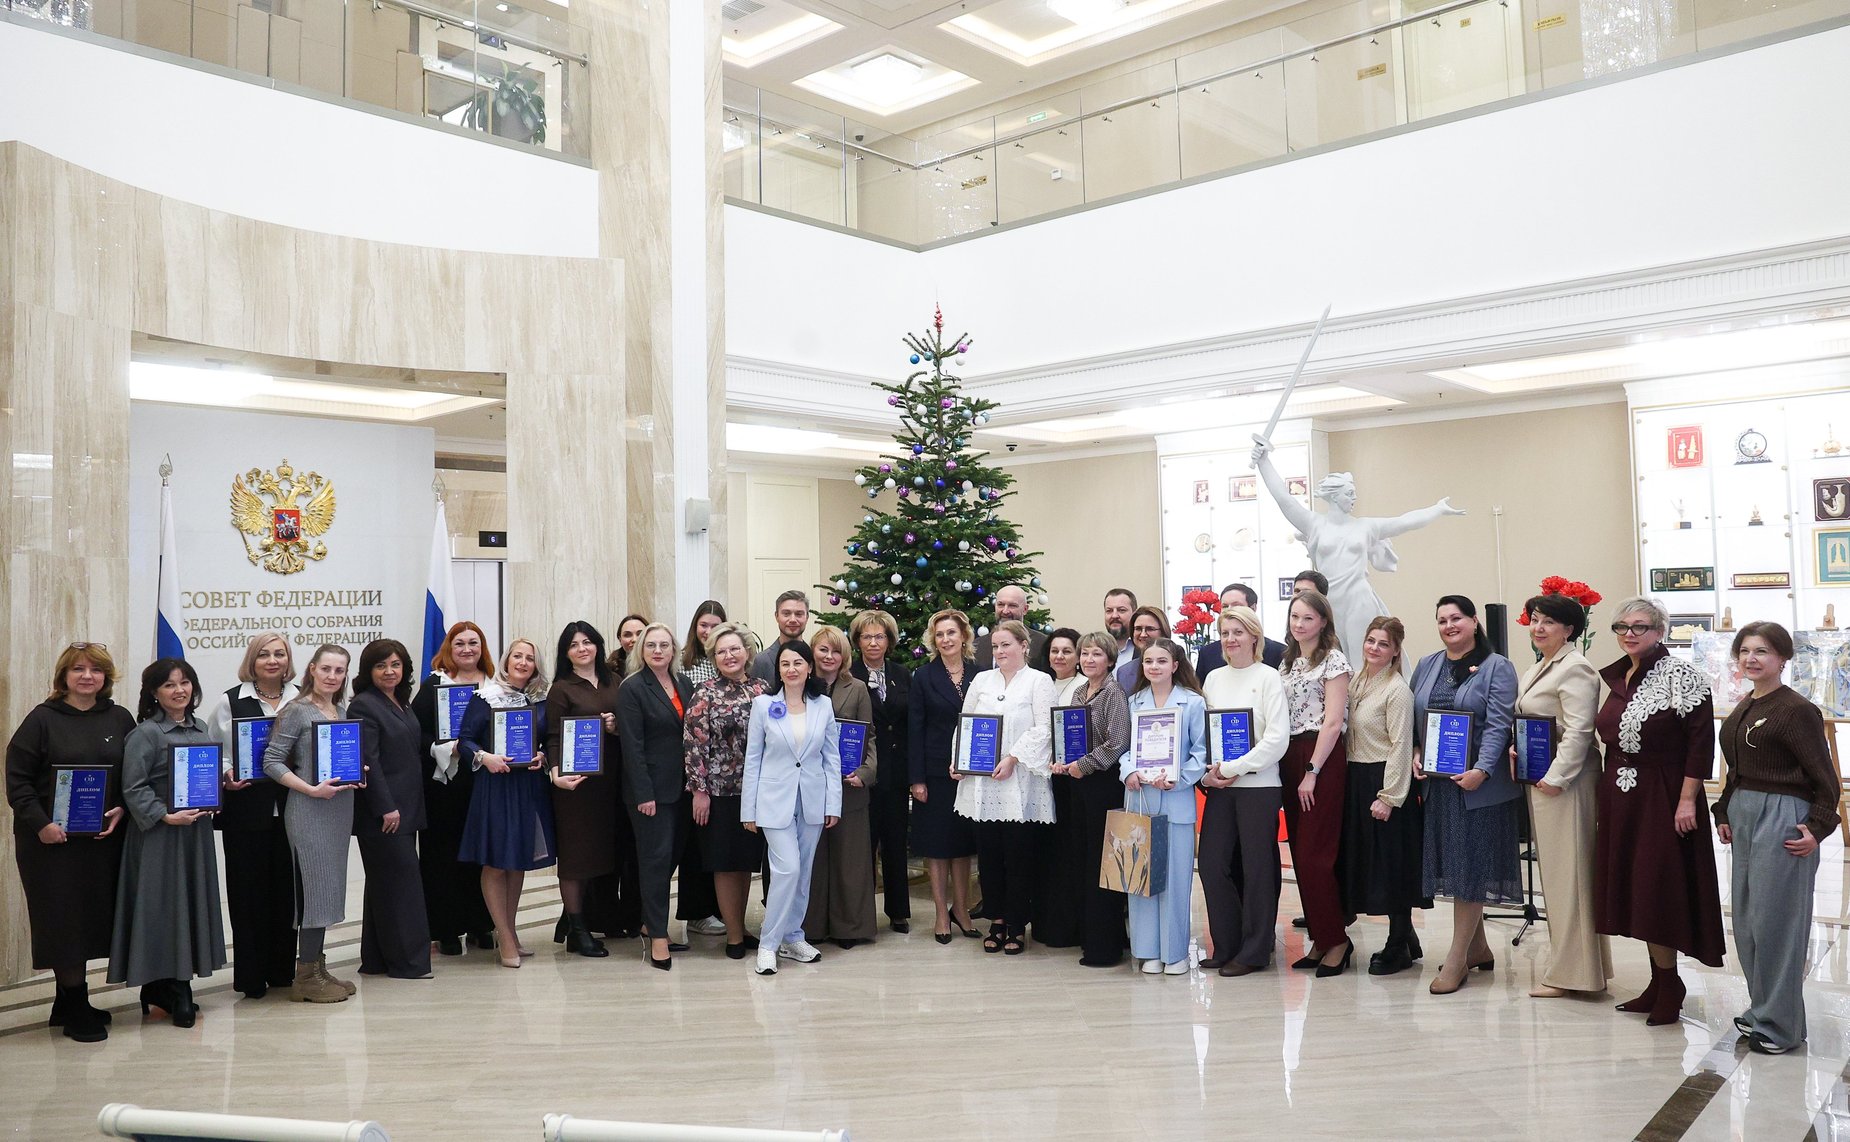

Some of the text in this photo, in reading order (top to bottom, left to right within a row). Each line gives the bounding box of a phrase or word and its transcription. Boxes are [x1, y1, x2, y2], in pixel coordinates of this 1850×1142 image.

[256, 590, 382, 610] ФЕДЕРАЦИИ
[306, 615, 382, 628] СОБРАНИЯ
[294, 630, 383, 646] ФЕДЕРАЦИИ
